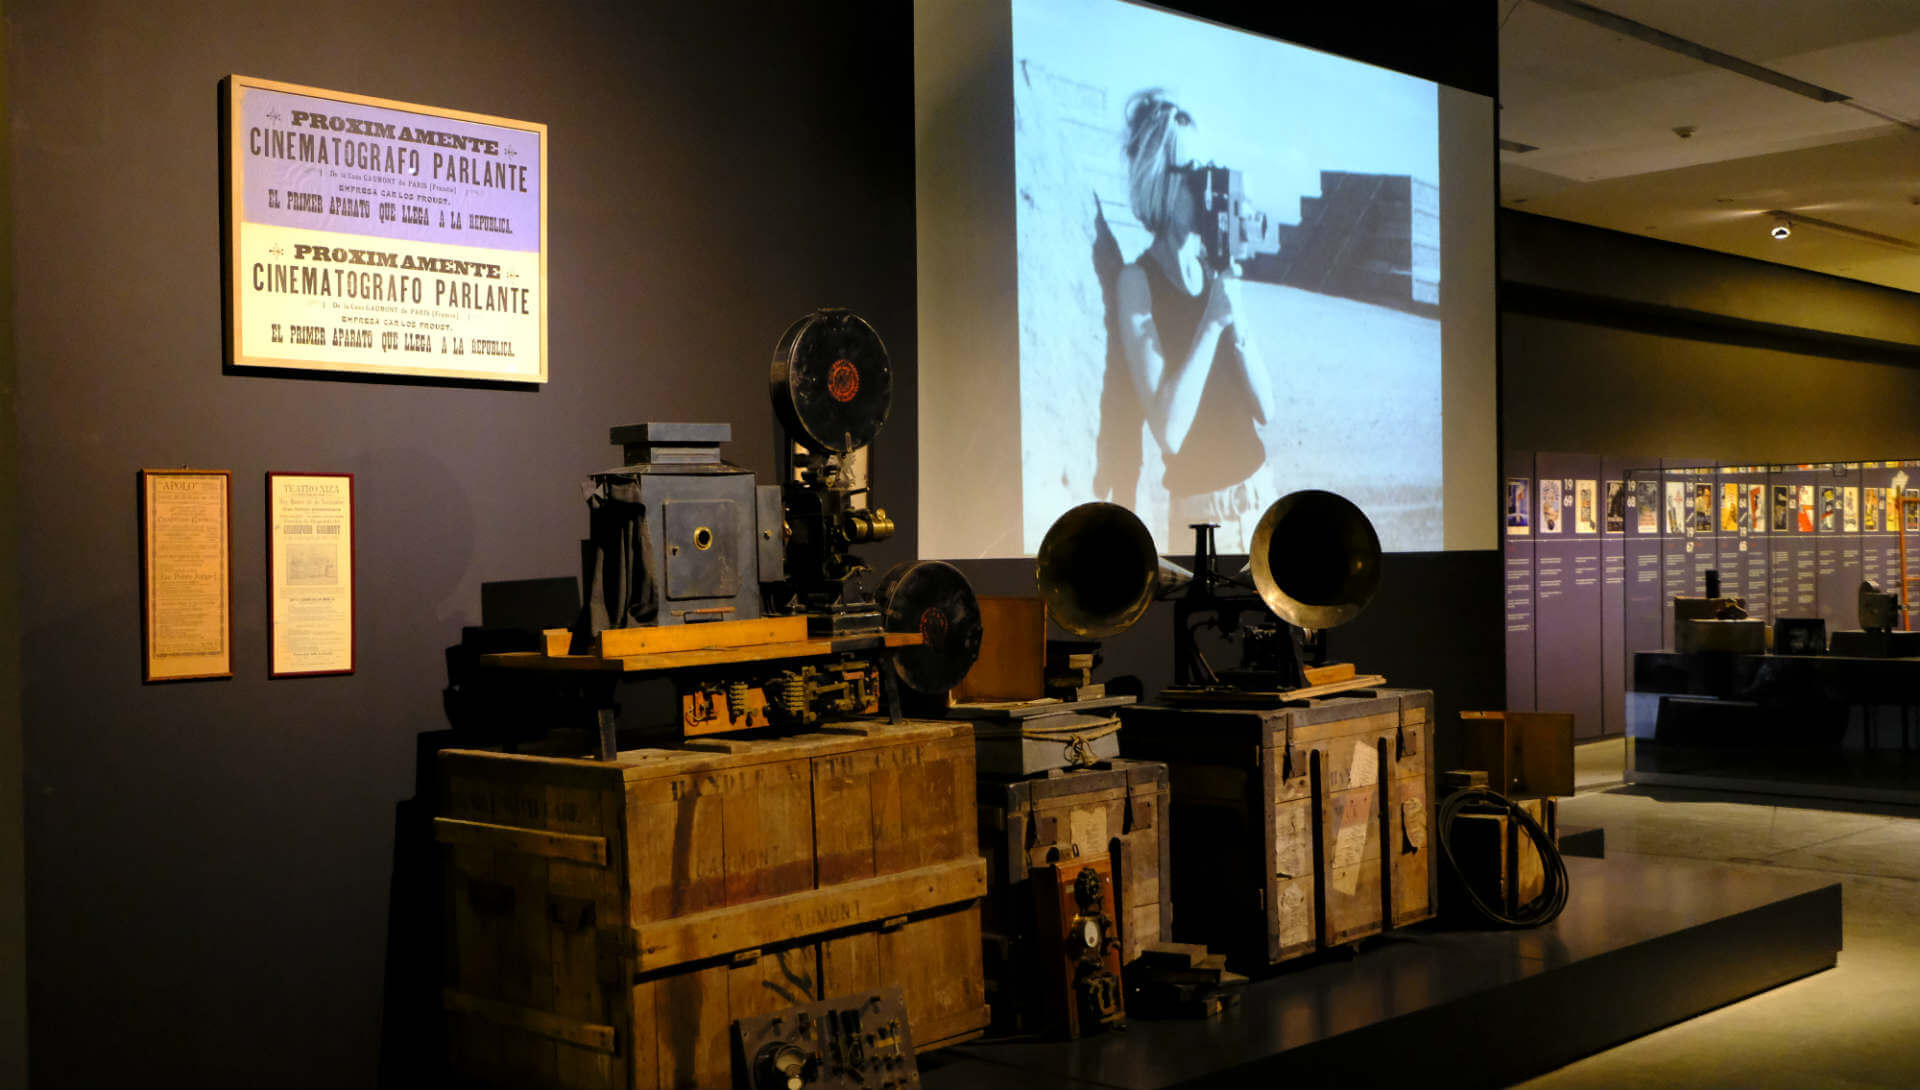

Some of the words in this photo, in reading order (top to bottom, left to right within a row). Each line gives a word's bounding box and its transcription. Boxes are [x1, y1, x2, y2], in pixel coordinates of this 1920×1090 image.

[291, 110, 498, 156] PROXIMAMENTE
[250, 127, 420, 176] CINEMATOGRAFO
[433, 152, 528, 193] PARLANTE
[339, 184, 377, 196] EMPRESA
[381, 189, 414, 201] CARLOS
[268, 189, 281, 209] EL
[287, 191, 323, 214] PRIMER
[329, 196, 370, 219] APARATO
[379, 202, 396, 224] QUE
[402, 204, 429, 226] LLEGA
[439, 209, 445, 228] A
[450, 211, 462, 230] LA
[294, 244, 501, 279] PROXIMAMENTE
[253, 262, 421, 304] CINEMATOGRAFO
[435, 278, 529, 315] PARLANTE
[271, 323, 283, 343] EL
[290, 325, 326, 346] PRIMER
[332, 328, 373, 349] APARATO
[381, 331, 398, 352] QUE
[404, 333, 431, 353] LLEGA
[441, 336, 447, 354] A
[453, 337, 464, 355] LA
[1563, 495, 1573, 507] 69
[1564, 478, 1573, 491] 19
[1627, 480, 1636, 492] 19
